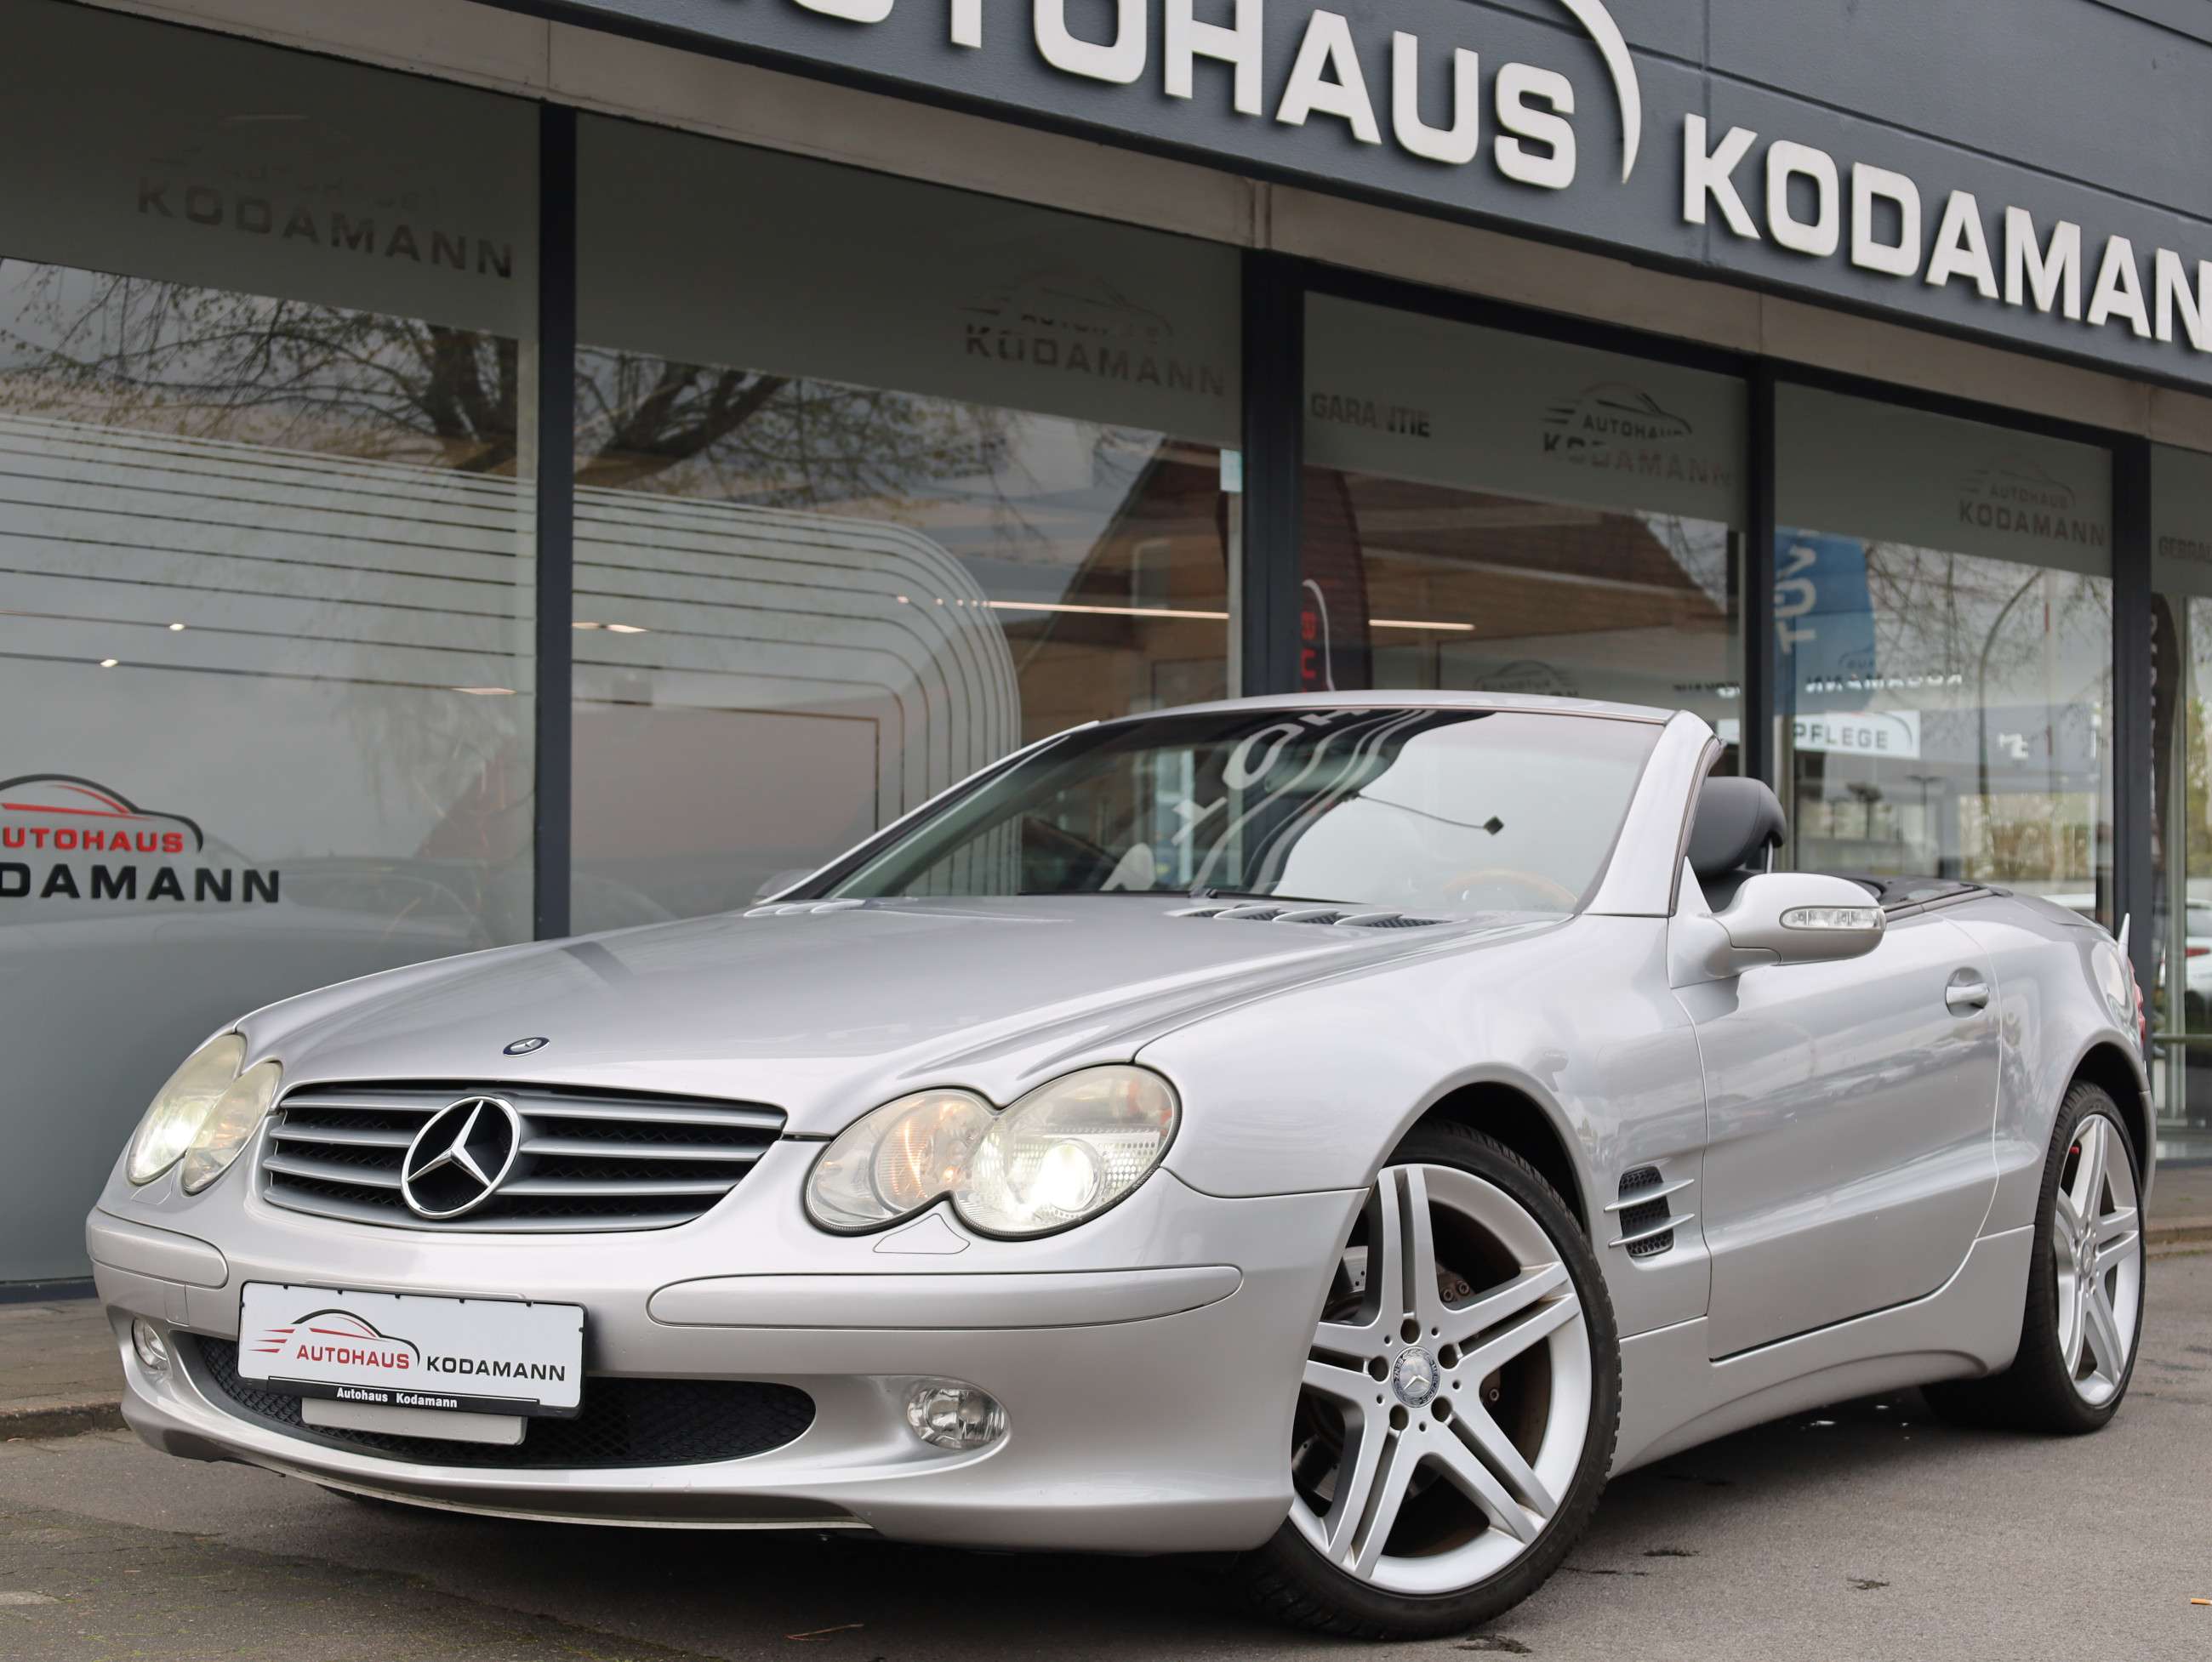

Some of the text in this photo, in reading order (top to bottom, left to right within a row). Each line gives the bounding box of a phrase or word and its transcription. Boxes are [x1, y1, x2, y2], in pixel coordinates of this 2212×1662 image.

[790, 0, 1576, 190] OHAUS
[138, 177, 512, 279] KODAMANN
[1311, 392, 1430, 438] GARATIE
[1959, 500, 2108, 546] KODAMANN
[296, 1345, 566, 1381] AUTOHAUS KODAMANN
[337, 1387, 458, 1409] Autohaus Kodamann
